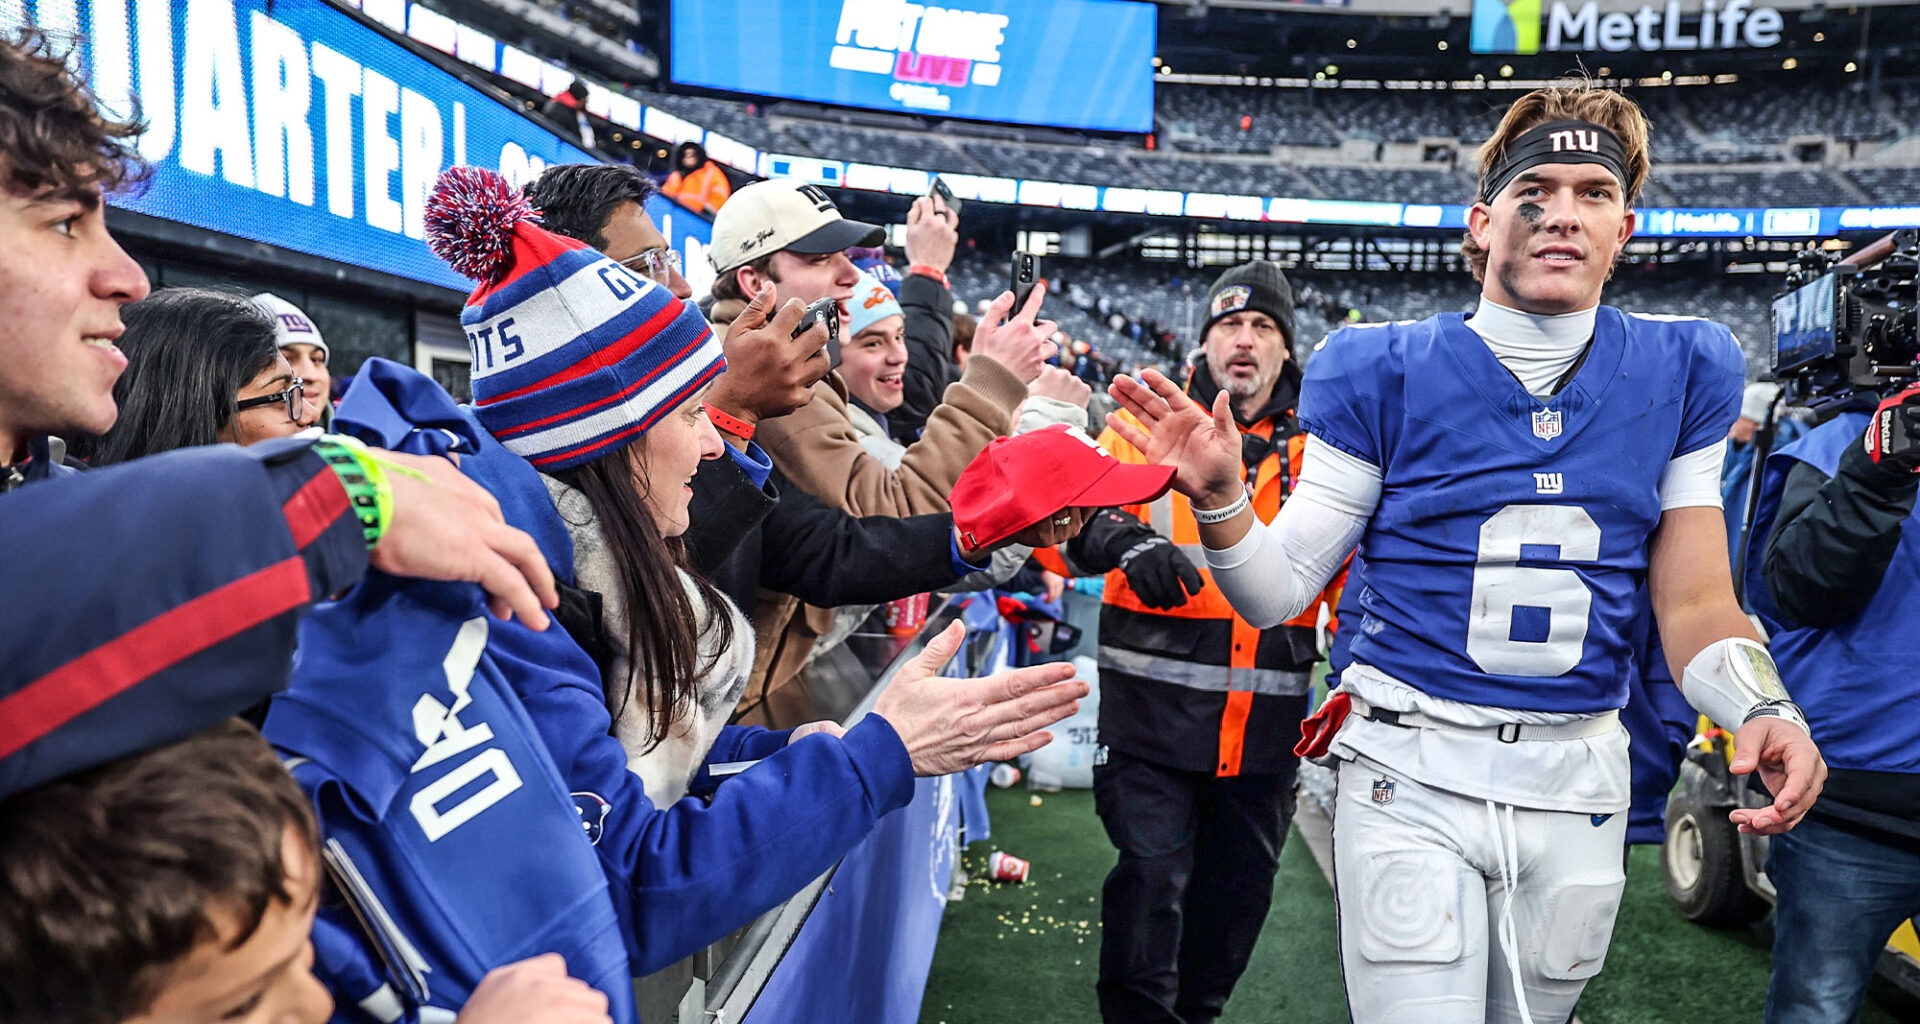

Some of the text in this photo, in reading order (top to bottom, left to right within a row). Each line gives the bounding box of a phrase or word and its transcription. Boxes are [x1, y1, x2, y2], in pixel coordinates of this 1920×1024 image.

[1546, 0, 1784, 51] MetLife
[896, 53, 970, 86] LIVE
[598, 263, 648, 301] GI
[1538, 423, 1557, 434] NFL
[1466, 504, 1602, 677] 6
[1374, 789, 1390, 801] NFL
